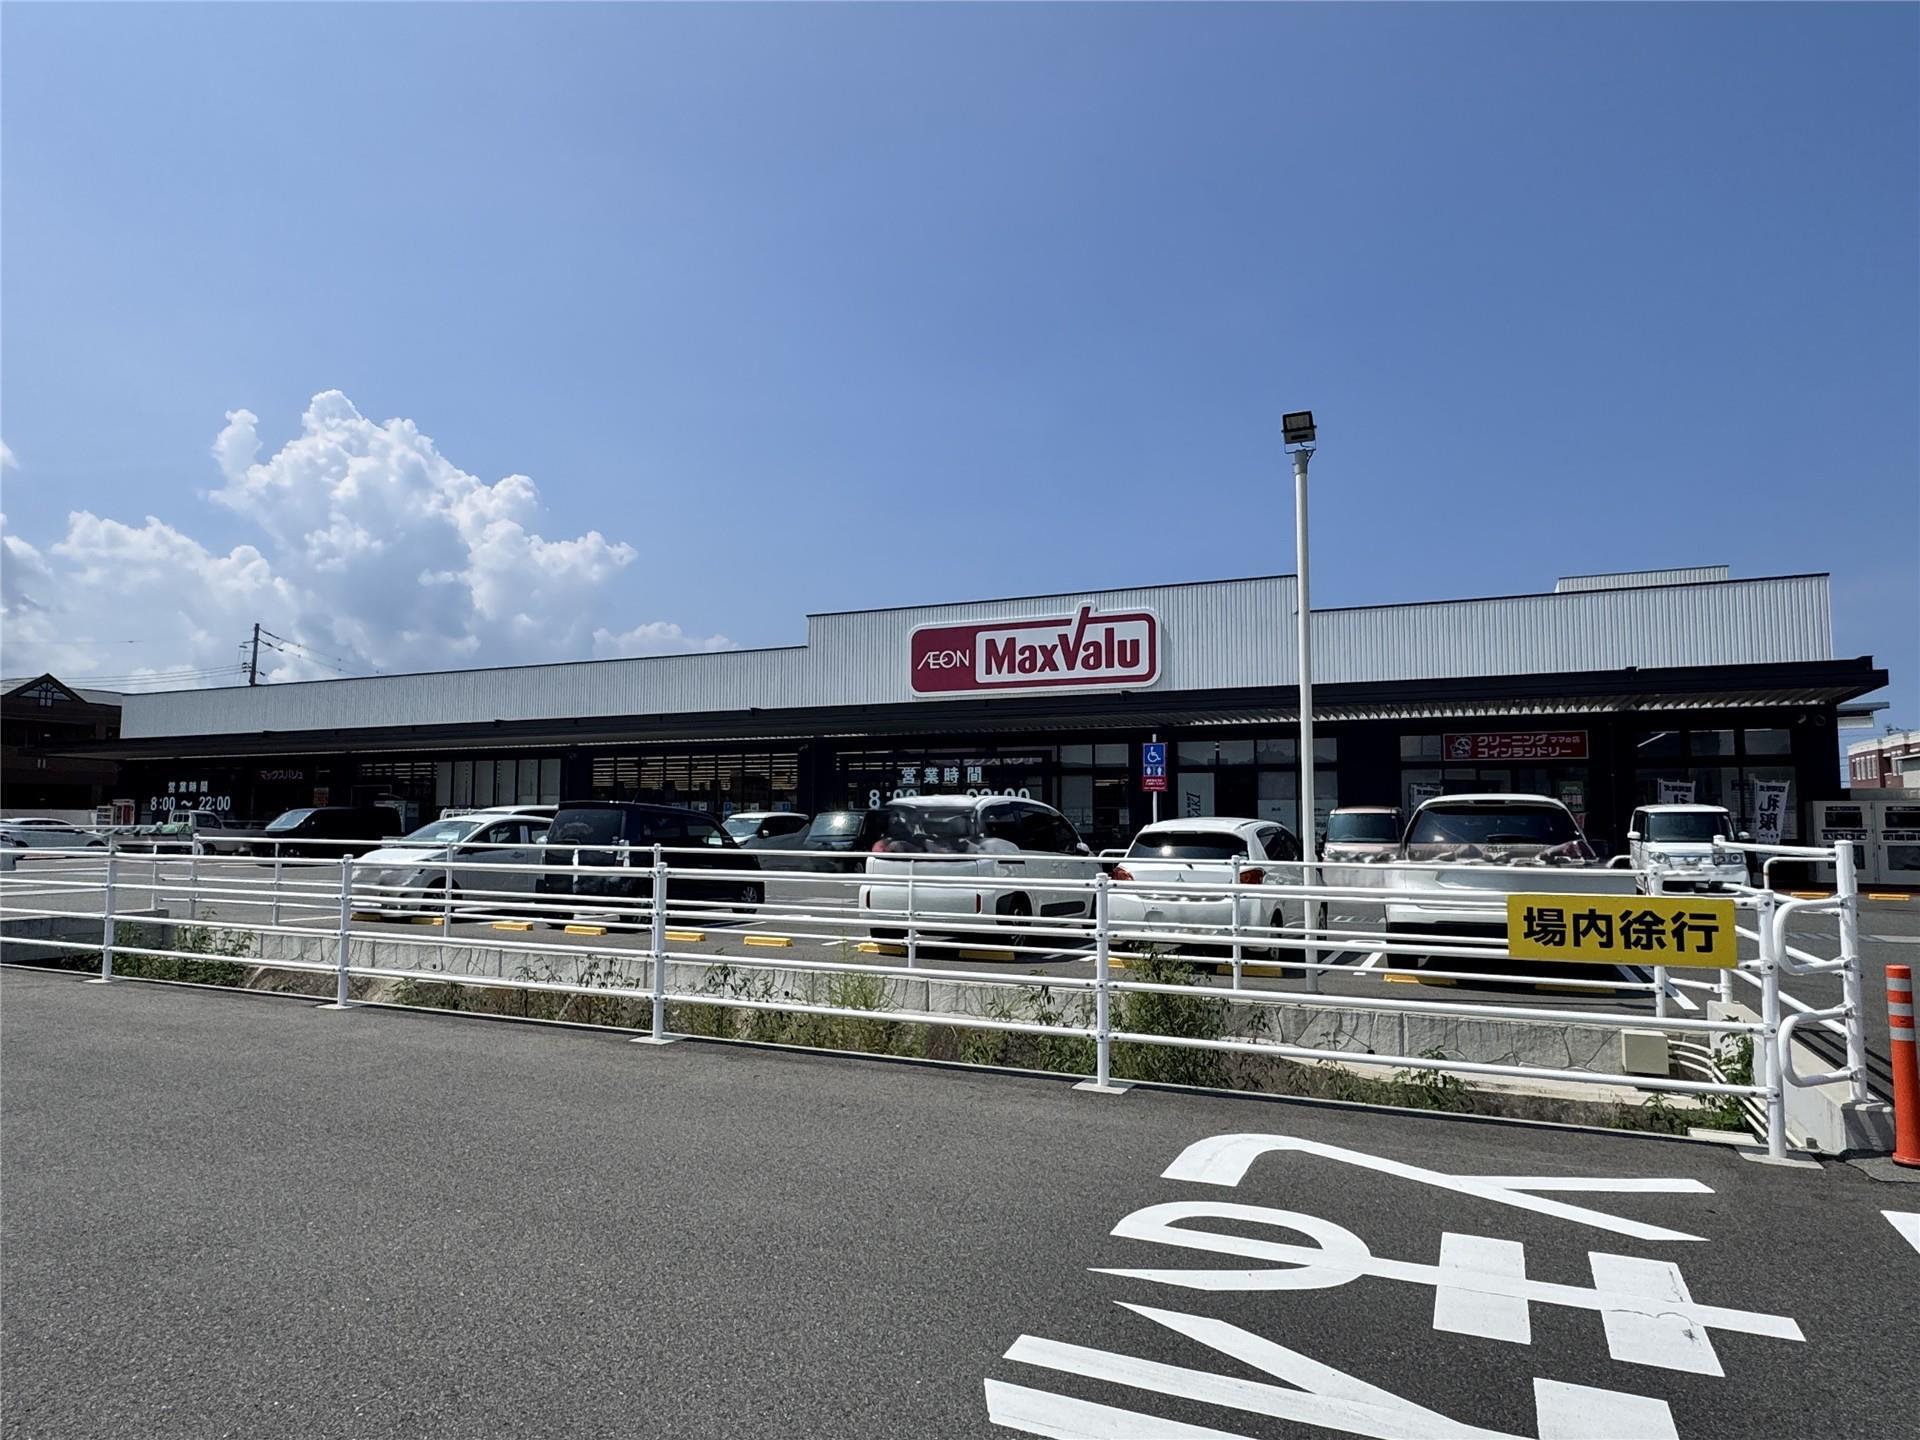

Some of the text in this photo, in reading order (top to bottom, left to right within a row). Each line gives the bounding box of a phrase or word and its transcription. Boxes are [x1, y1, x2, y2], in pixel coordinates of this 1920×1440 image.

[984, 606, 1140, 676] MaxValu
[1477, 734, 1548, 746] クリーニング
[1477, 746, 1572, 758] コインランドリー
[901, 766, 983, 785] 営業時間
[168, 780, 208, 793] 営業時間
[150, 797, 175, 811] 8:00
[199, 796, 231, 811] 22:00
[1523, 906, 1719, 953] 場内徐行
